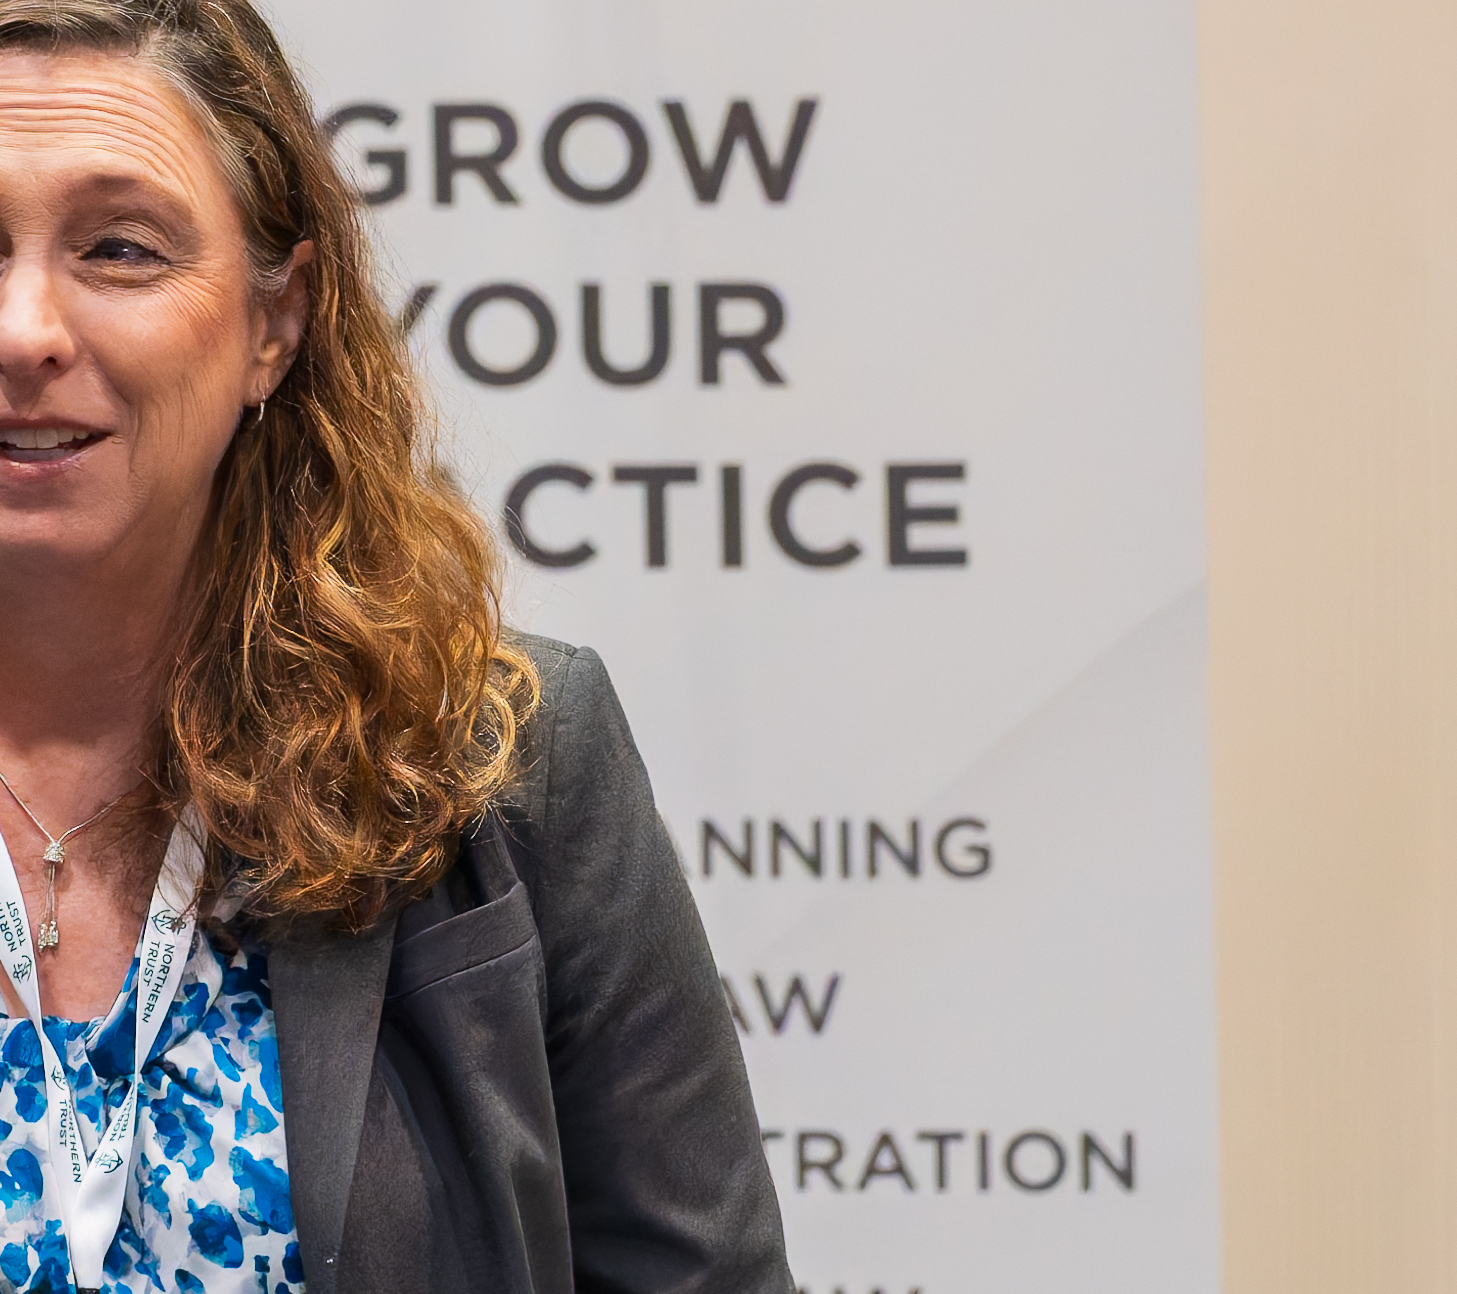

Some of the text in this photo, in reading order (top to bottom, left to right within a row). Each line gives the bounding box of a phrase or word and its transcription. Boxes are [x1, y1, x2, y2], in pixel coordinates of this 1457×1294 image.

[323, 99, 821, 206] GROW
[689, 817, 993, 879] NNING
[6, 900, 25, 947] TRUST
[142, 943, 176, 1024] NORTHERN
[143, 941, 161, 987] TRUST
[59, 1099, 68, 1148] TRUST
